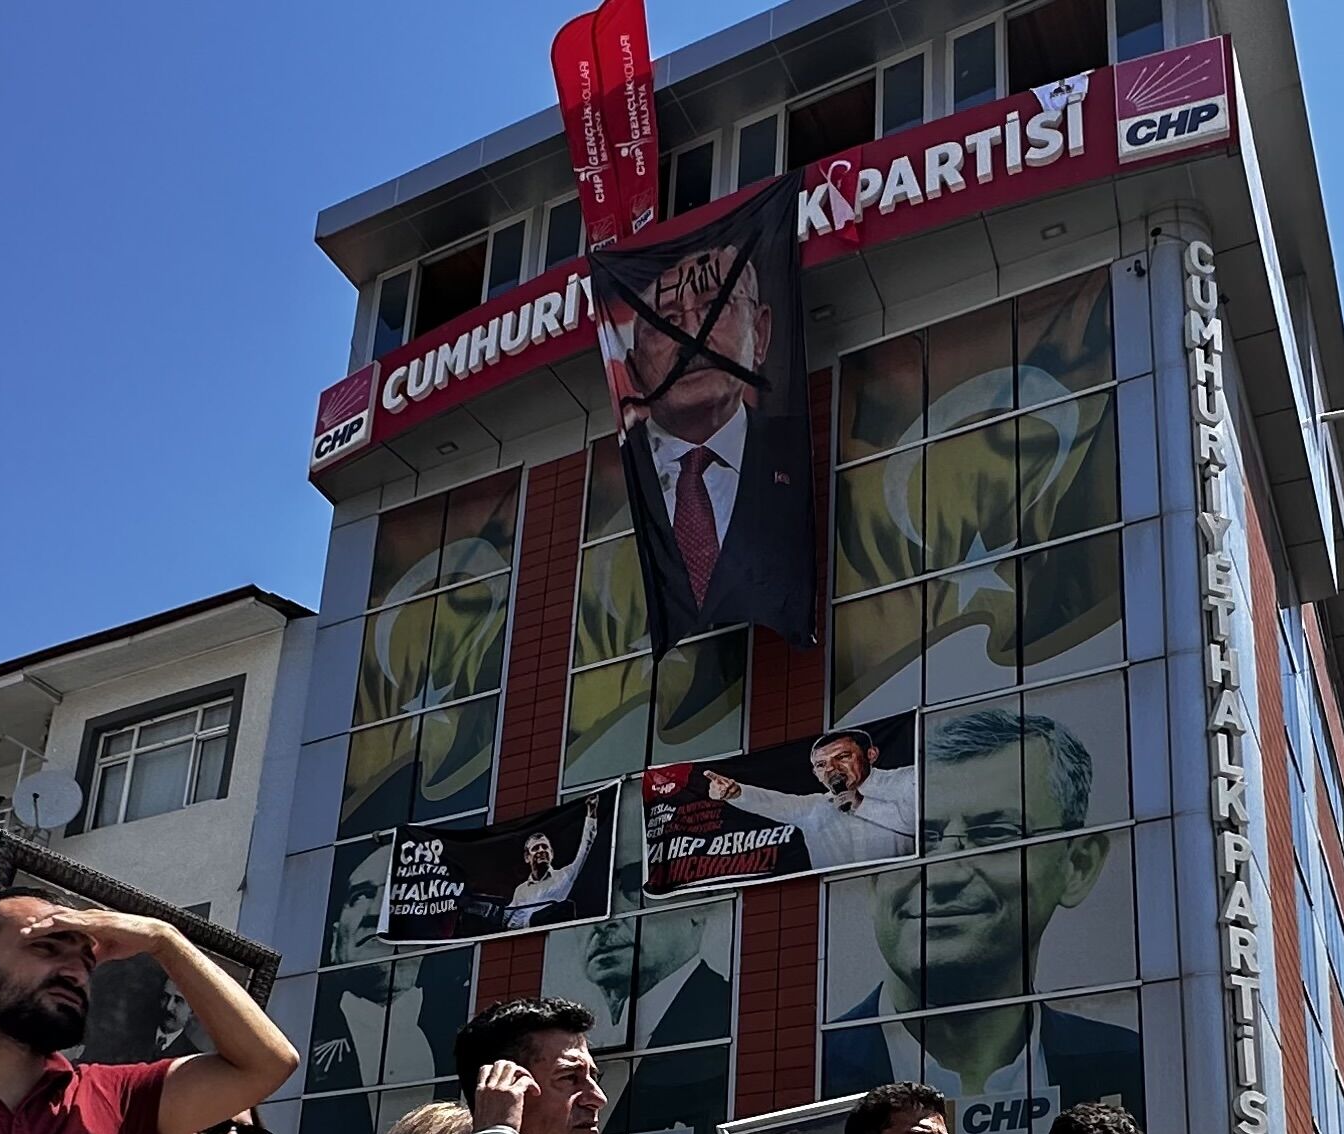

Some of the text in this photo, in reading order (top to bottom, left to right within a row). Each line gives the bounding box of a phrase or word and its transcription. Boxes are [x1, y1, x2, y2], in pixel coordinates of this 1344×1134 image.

[1125, 102, 1219, 146] CHP
[634, 148, 646, 176] CHP
[854, 91, 1085, 223] PARTİSİ
[592, 174, 605, 203] CHP
[314, 416, 364, 459] CHP
[1184, 240, 1236, 643] CUMHURİYET
[1206, 644, 1249, 824] HALK
[400, 839, 444, 865] CHP
[667, 836, 706, 861] HEP
[706, 823, 795, 856] BERABER
[391, 879, 465, 901] HALKIN
[961, 1097, 1051, 1134] CHP
